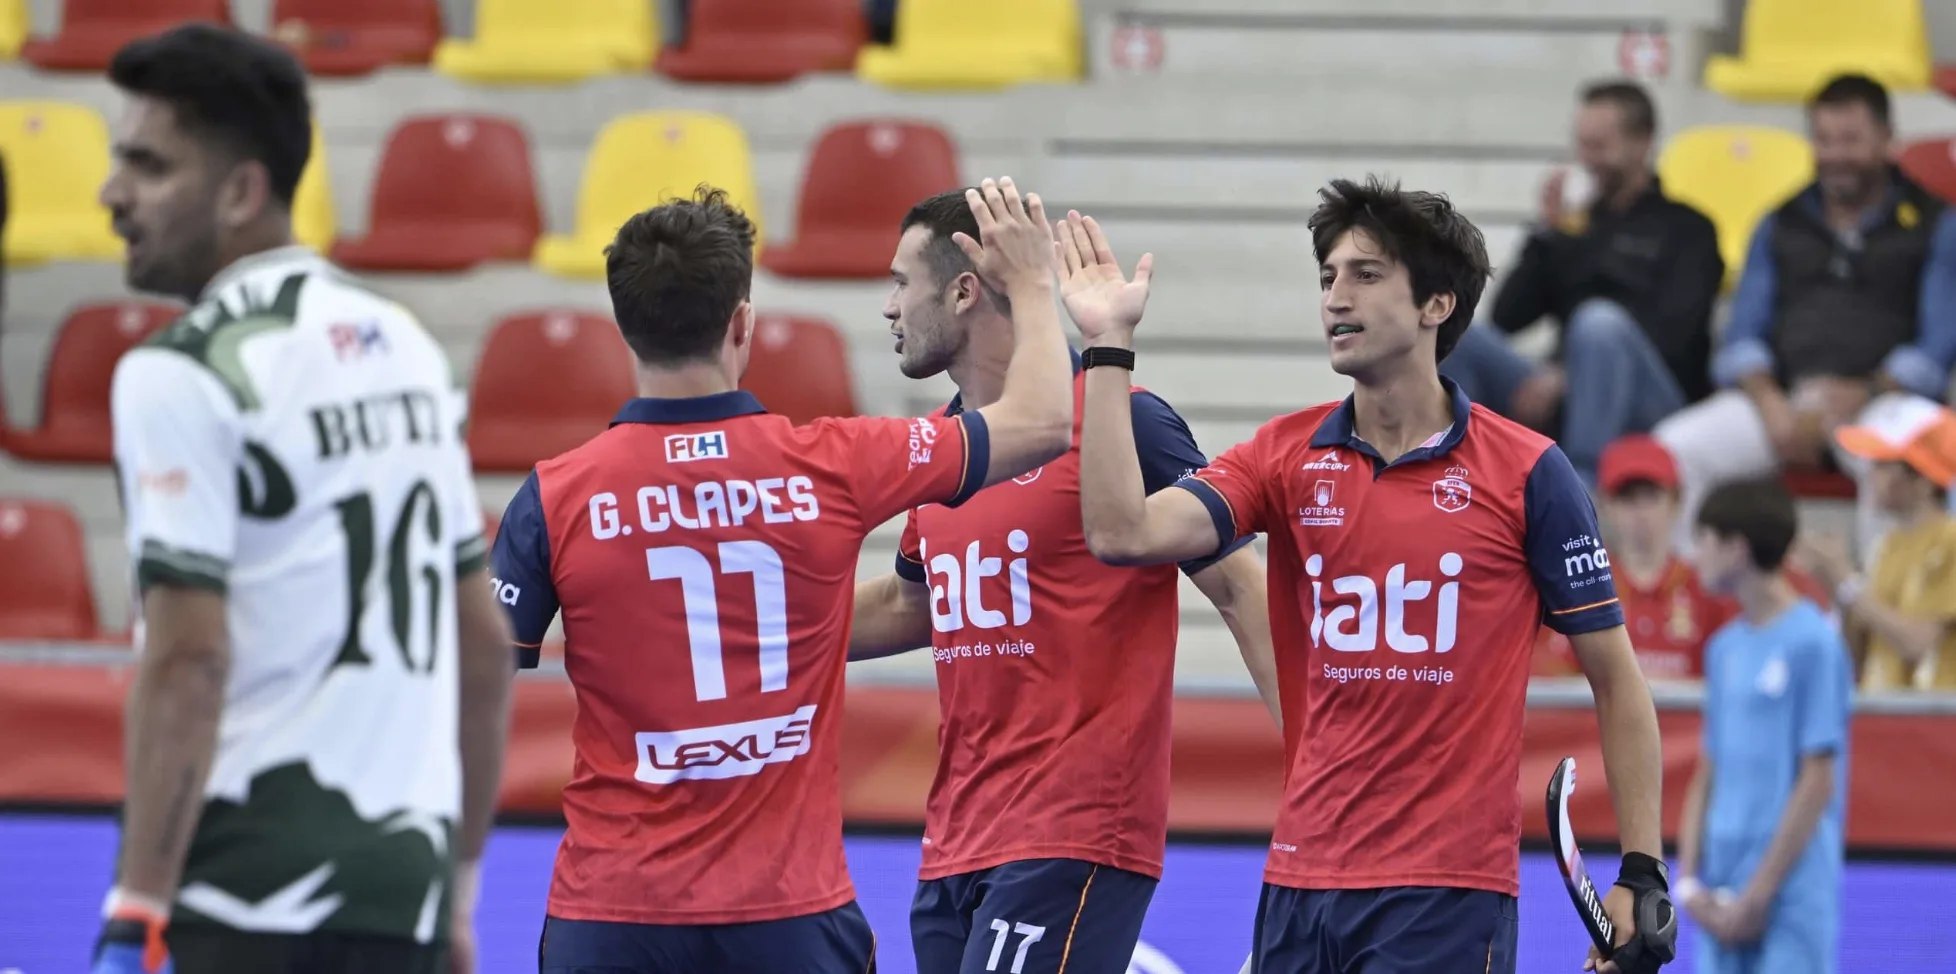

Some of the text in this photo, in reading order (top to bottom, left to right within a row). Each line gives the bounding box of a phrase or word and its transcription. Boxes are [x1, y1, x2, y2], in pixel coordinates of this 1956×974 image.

[589, 475, 819, 540] G. CLAPES
[1562, 534, 1591, 551] visit
[331, 478, 442, 675] 16
[919, 529, 1032, 632] iati
[1305, 552, 1463, 653] iati
[1570, 580, 1585, 589] the
[646, 540, 788, 702] 11
[933, 639, 1035, 663] Seguros de viaje
[1323, 663, 1454, 685] Seguros de viaje
[647, 719, 809, 770] LEXUS
[1580, 875, 1612, 944] ritual
[986, 918, 1046, 974] 17
